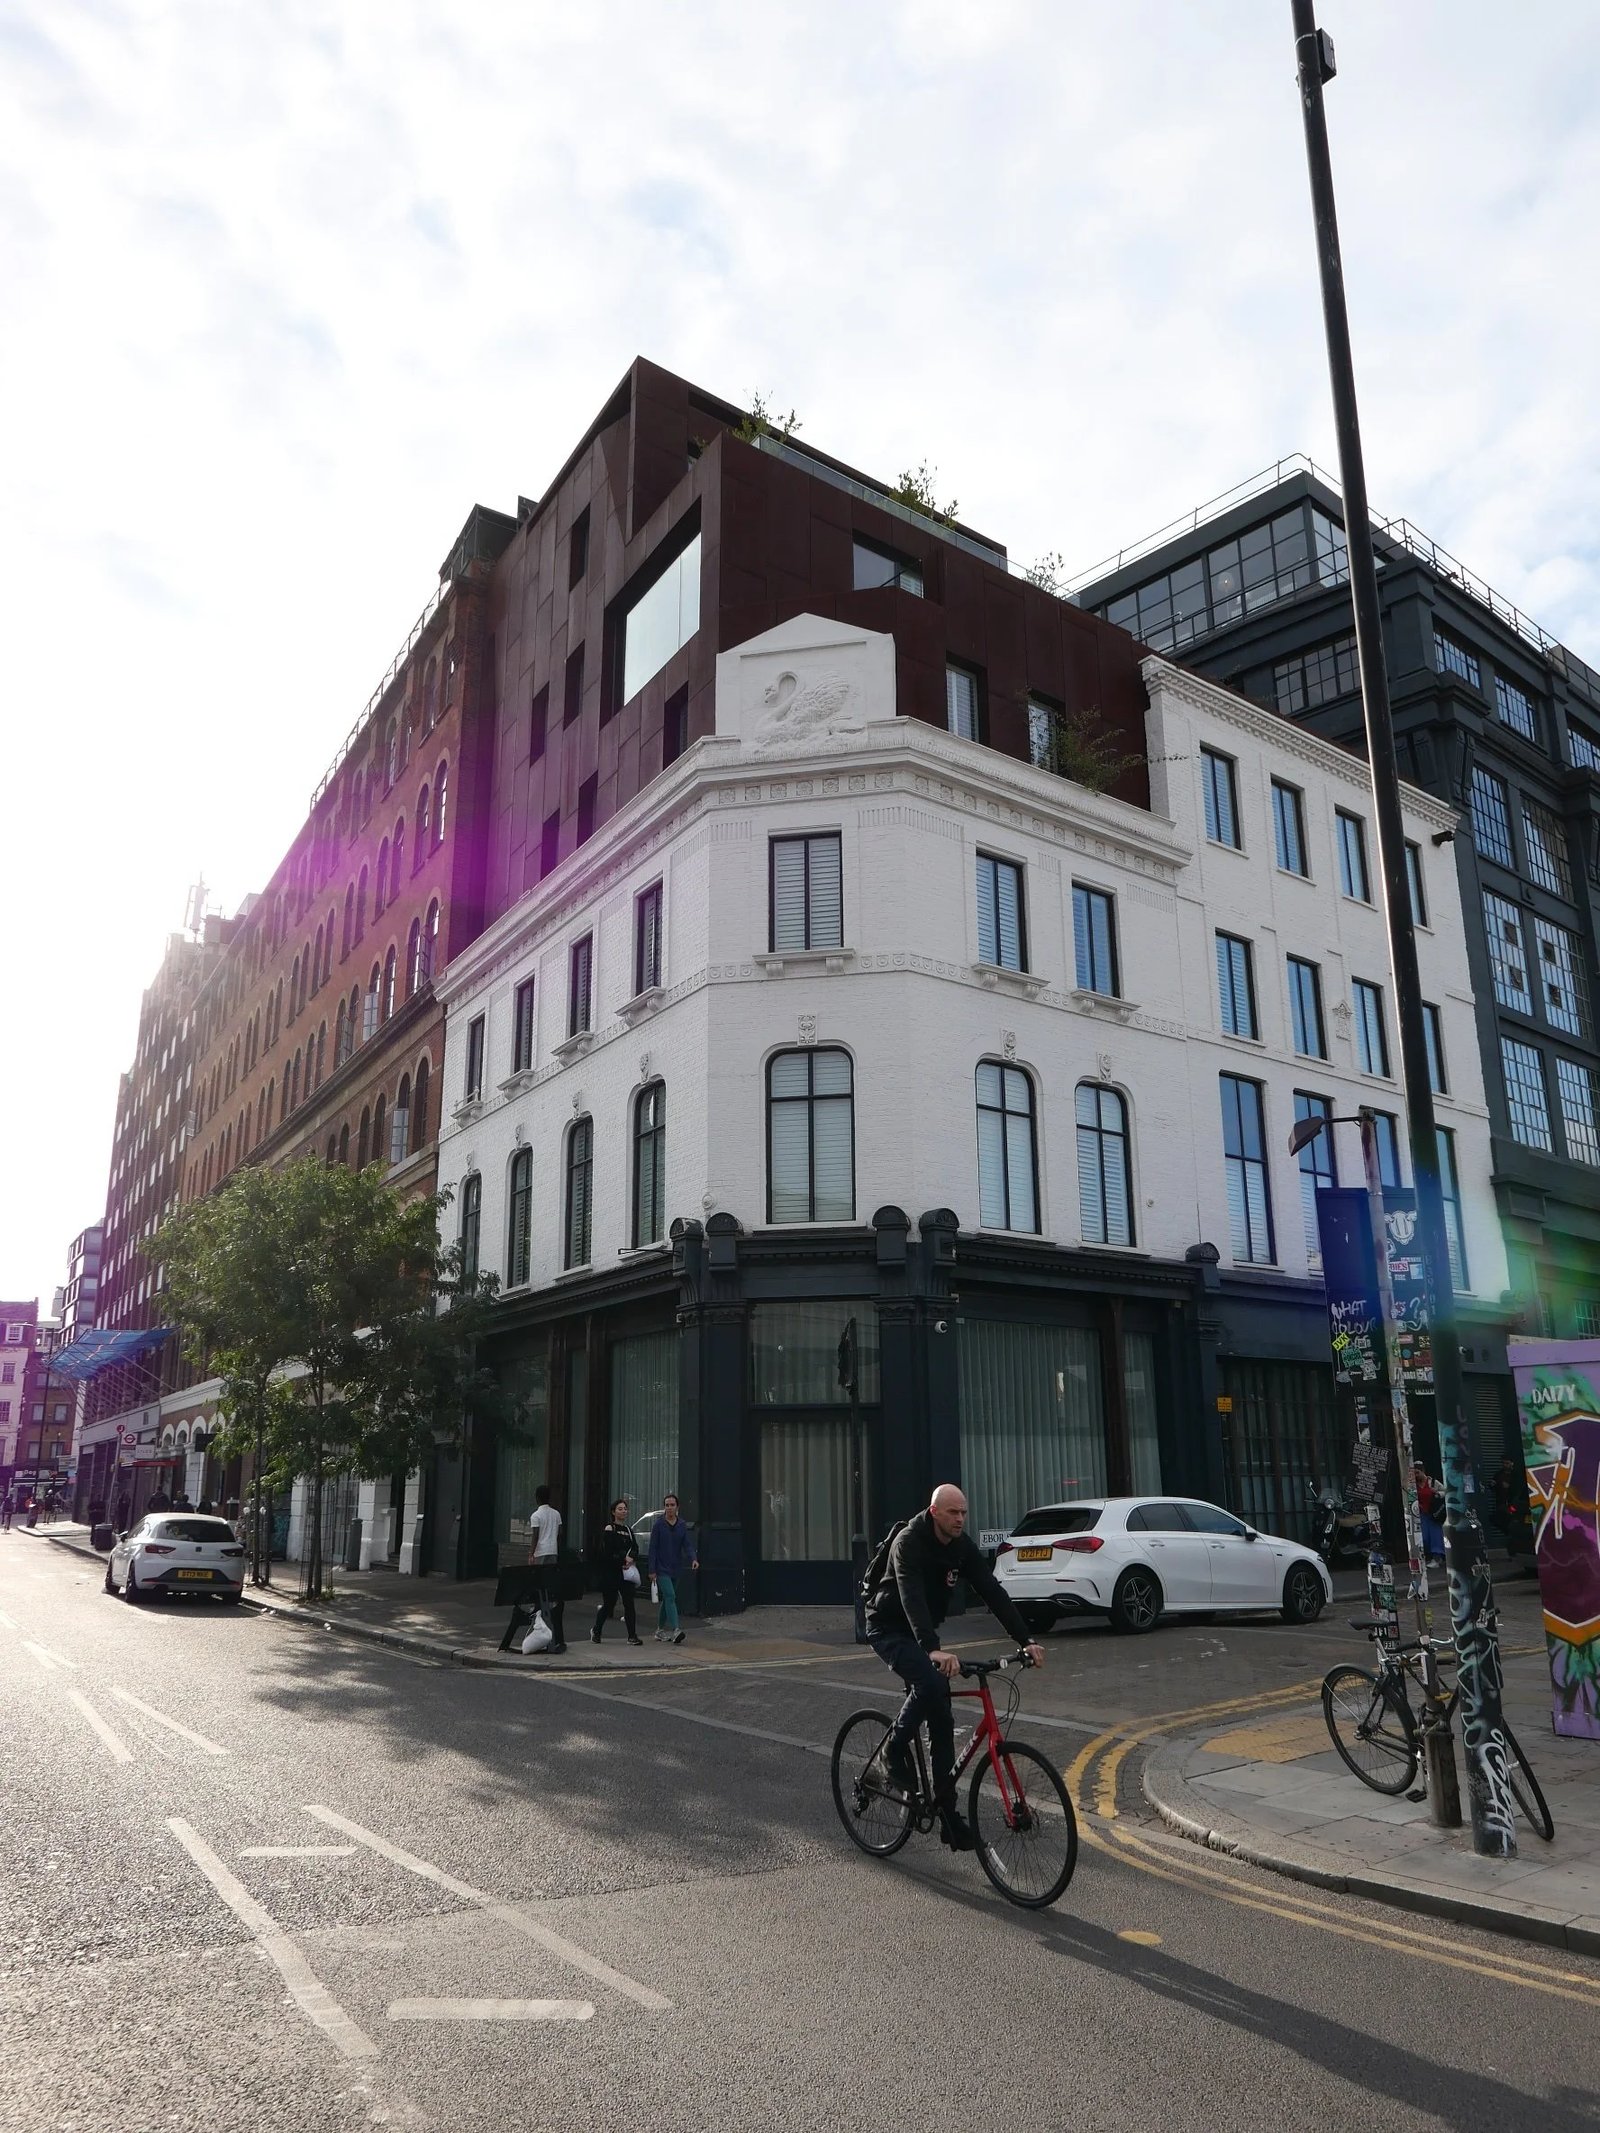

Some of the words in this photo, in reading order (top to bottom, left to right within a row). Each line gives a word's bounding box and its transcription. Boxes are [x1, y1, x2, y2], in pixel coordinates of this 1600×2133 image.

[1331, 1300, 1366, 1319] WHAT
[1333, 1334, 1349, 1350] JVK
[983, 1534, 1004, 1543] EBOR
[949, 1730, 979, 1777] TREK
